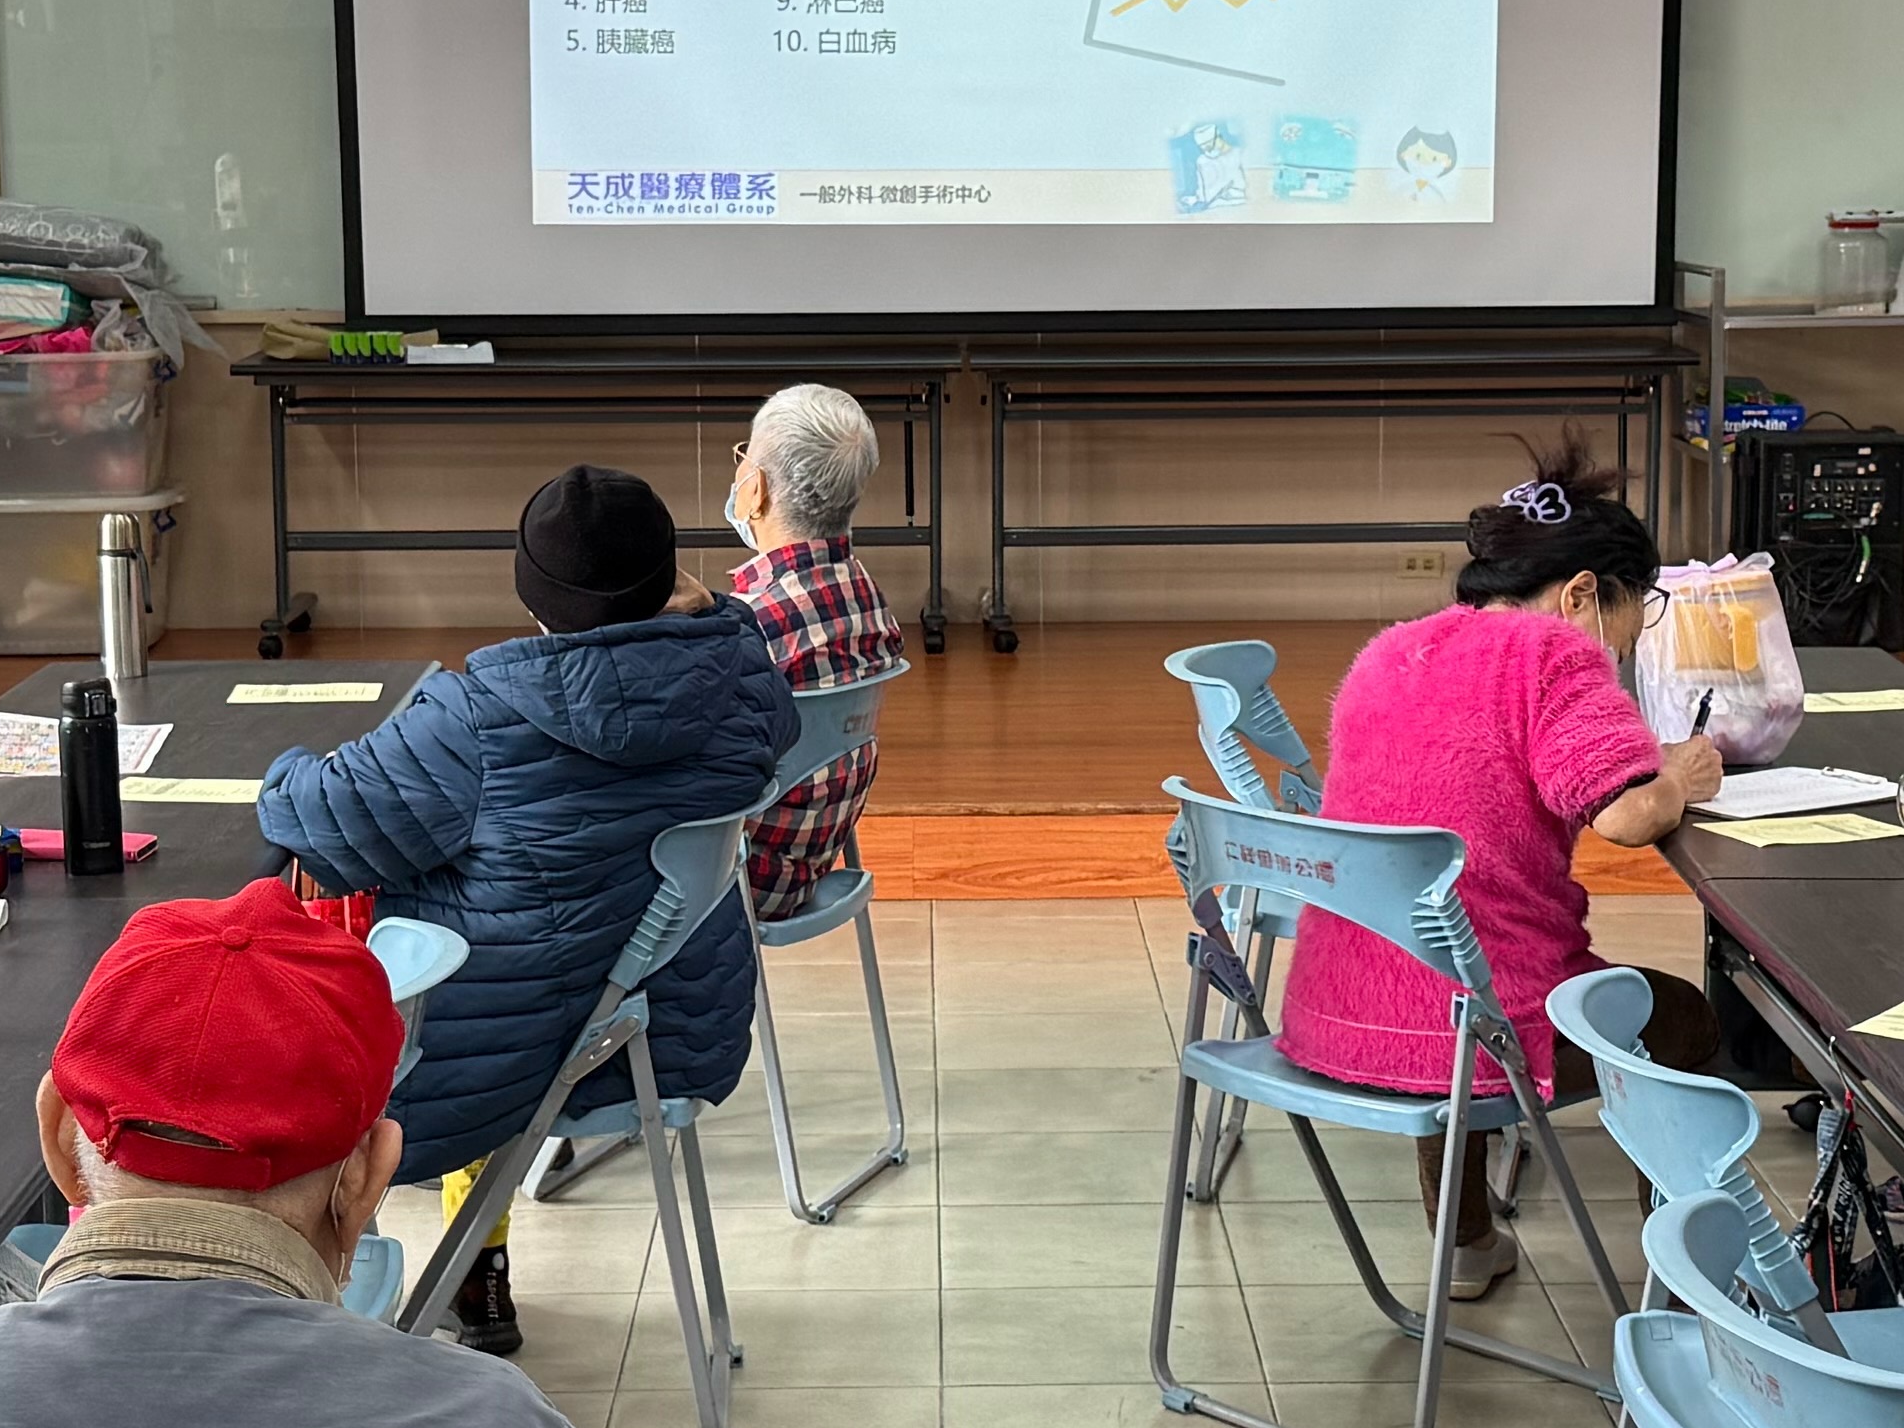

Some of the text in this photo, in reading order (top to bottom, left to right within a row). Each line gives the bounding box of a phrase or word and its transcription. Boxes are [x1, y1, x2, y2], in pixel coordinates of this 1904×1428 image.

[566, 28, 676, 55] 5. 胰臟癌
[773, 28, 897, 55] 10. 白血病
[567, 172, 777, 201] 天成醫療體系
[568, 202, 777, 217] Ten-Chen Medical Group
